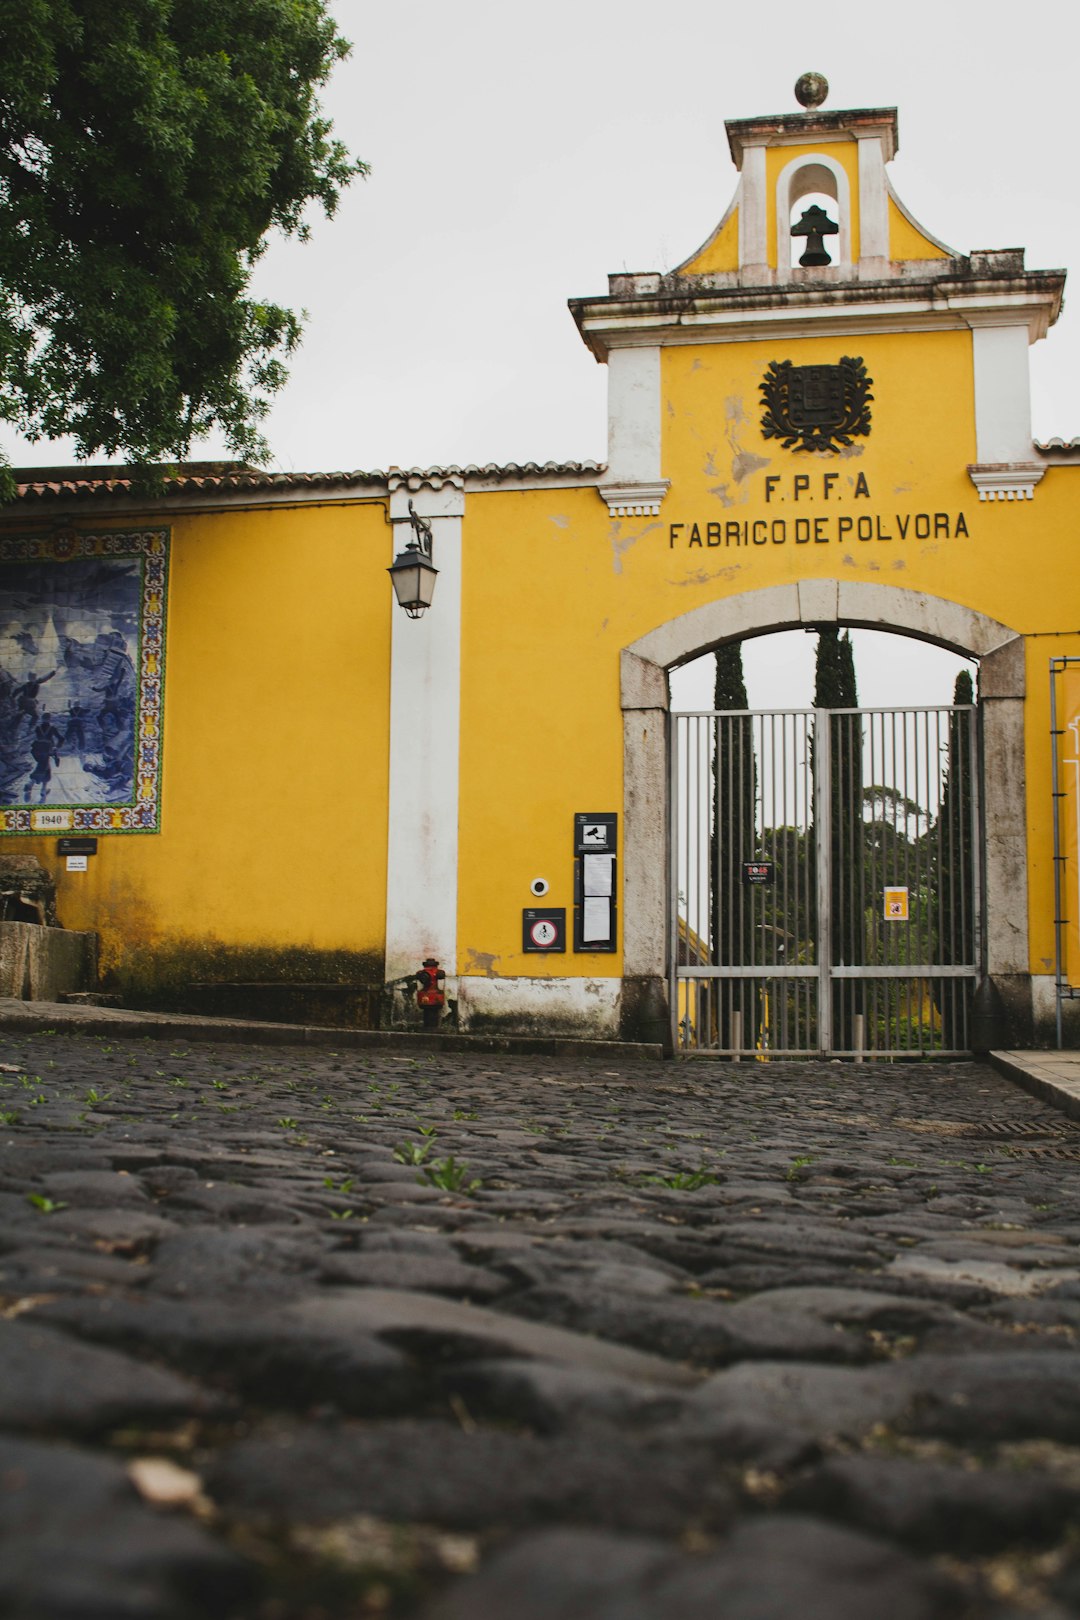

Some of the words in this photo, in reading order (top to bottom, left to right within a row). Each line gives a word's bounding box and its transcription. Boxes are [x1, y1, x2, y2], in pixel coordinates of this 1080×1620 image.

[670, 519, 787, 548] FABRICO
[795, 517, 829, 544] DE
[838, 512, 969, 542] POLVORA
[41, 815, 62, 825] 1940
